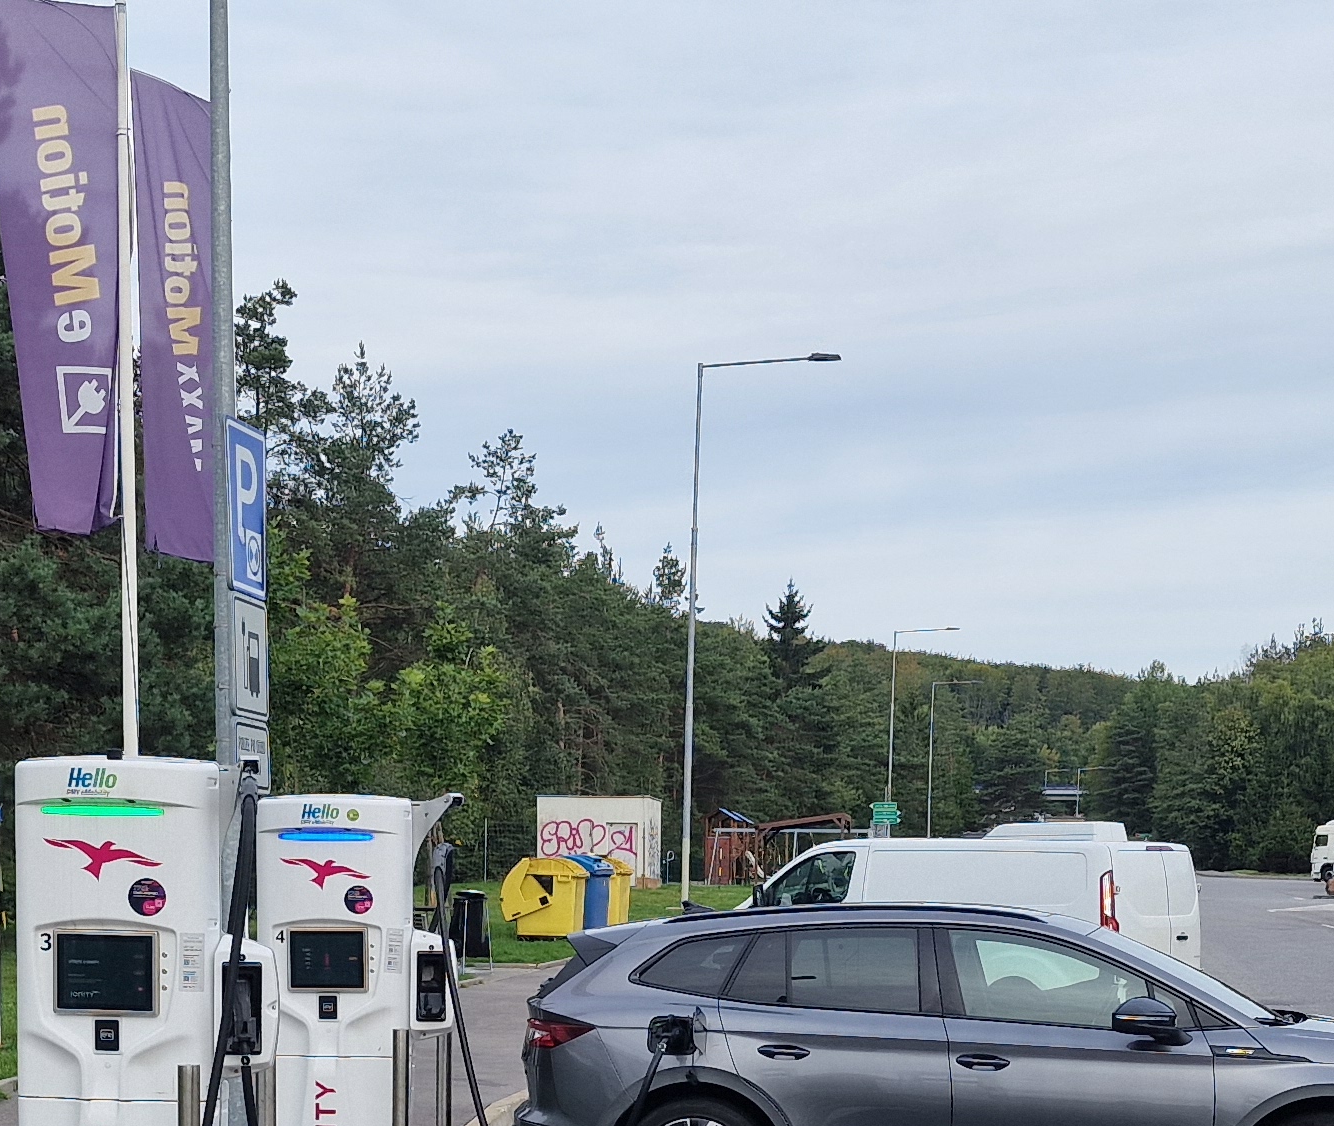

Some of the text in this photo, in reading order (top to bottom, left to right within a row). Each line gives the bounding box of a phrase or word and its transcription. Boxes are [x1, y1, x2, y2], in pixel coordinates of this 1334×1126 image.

[235, 443, 258, 546] P
[67, 767, 118, 789] Hello
[301, 803, 340, 820] Hello
[39, 932, 53, 951] 3
[275, 929, 286, 944] 4
